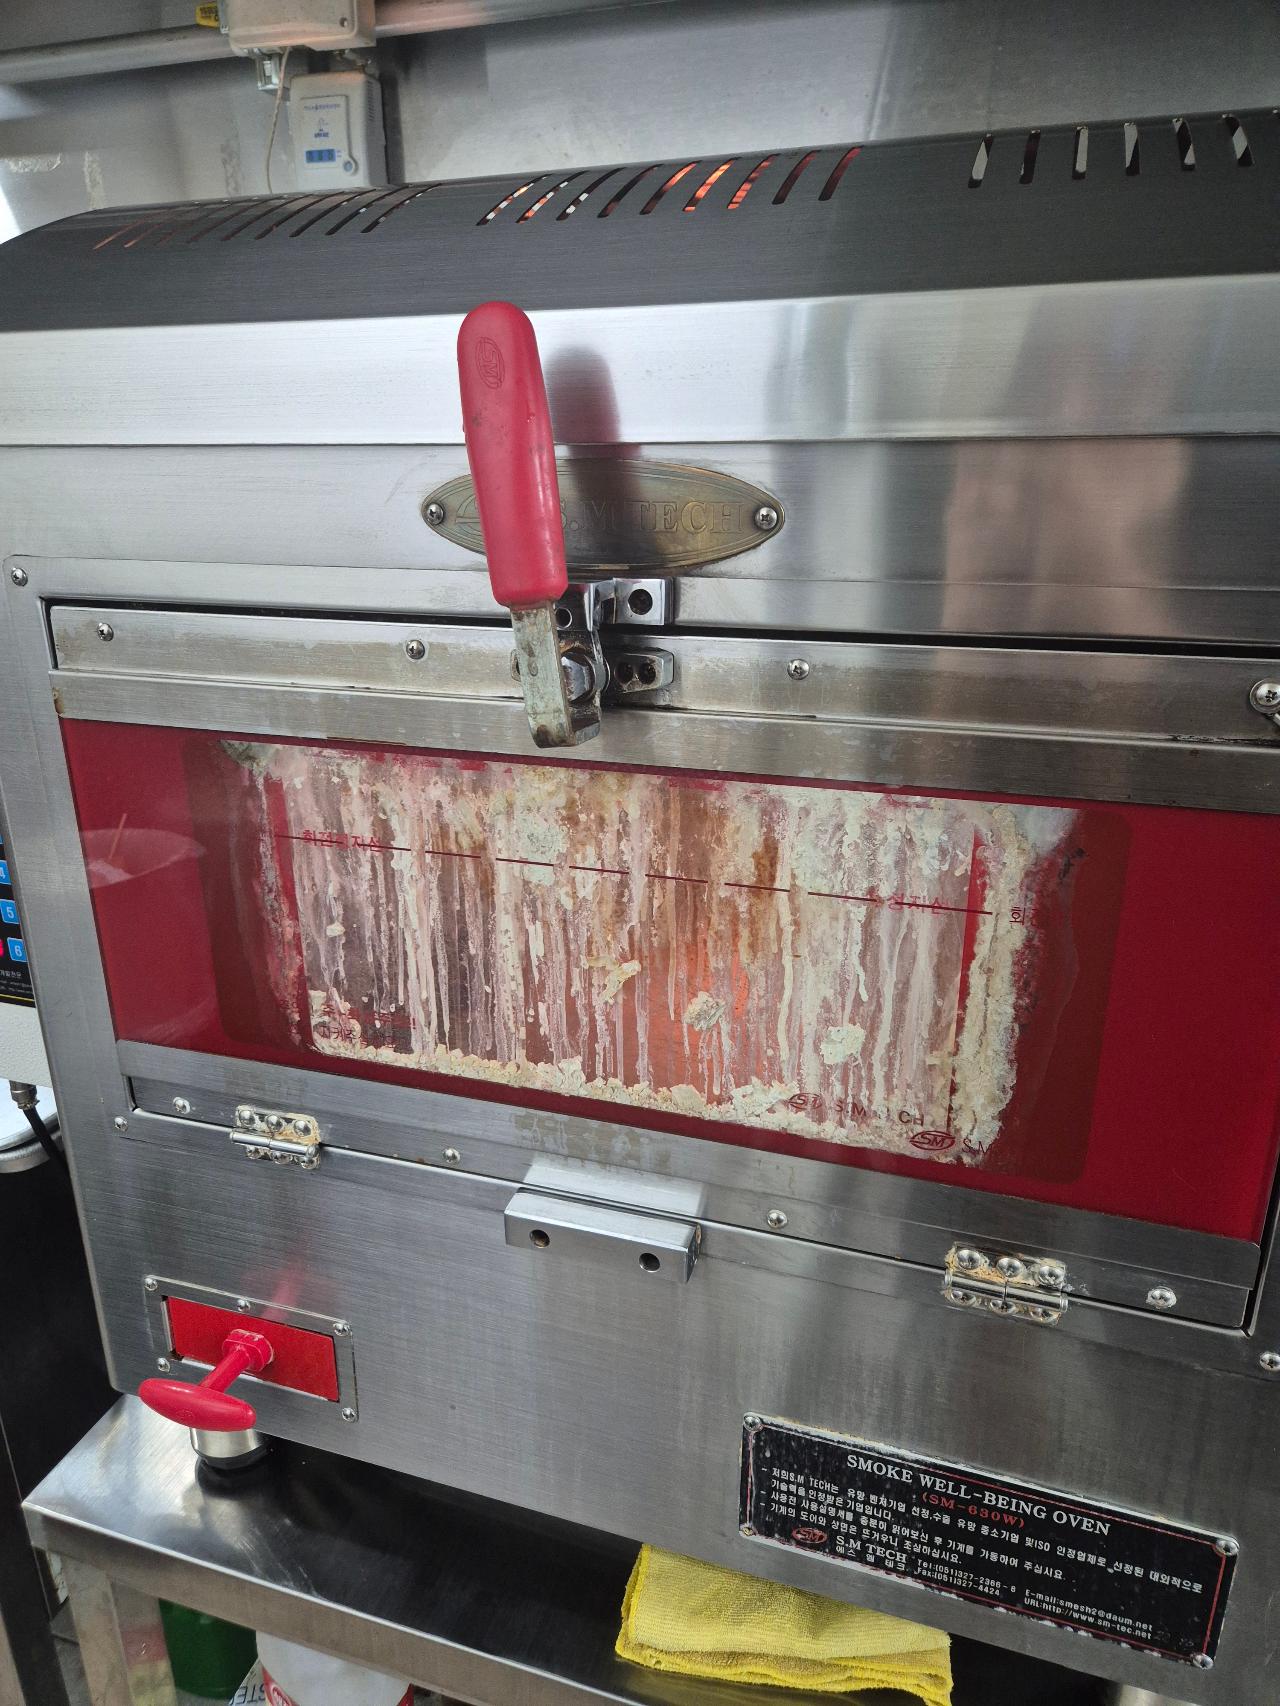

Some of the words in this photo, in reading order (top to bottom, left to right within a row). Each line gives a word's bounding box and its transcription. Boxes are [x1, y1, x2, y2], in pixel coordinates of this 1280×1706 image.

[623, 500, 746, 533] TECH
[6, 906, 15, 919] 5
[14, 944, 23, 957] 6
[847, 1454, 913, 1483] SMOKE
[919, 1473, 1047, 1520] WELL-BEING
[1053, 1510, 1111, 1536] OVEN
[770, 1503, 795, 1517] 기계의
[800, 1511, 826, 1526] 도어와
[862, 1528, 898, 1546] 뜨거우니
[771, 1491, 796, 1506] 사용전
[934, 1536, 943, 1546] 후
[809, 1477, 839, 1494] TECH는
[847, 1488, 864, 1501] 유망
[957, 1518, 976, 1531] 유망
[980, 1524, 1020, 1544] 중소기업
[1113, 1560, 1144, 1578] 선정된
[1149, 1570, 1203, 1594] 대외적으로
[836, 1535, 861, 1550] S.M
[865, 1543, 907, 1563] TECH
